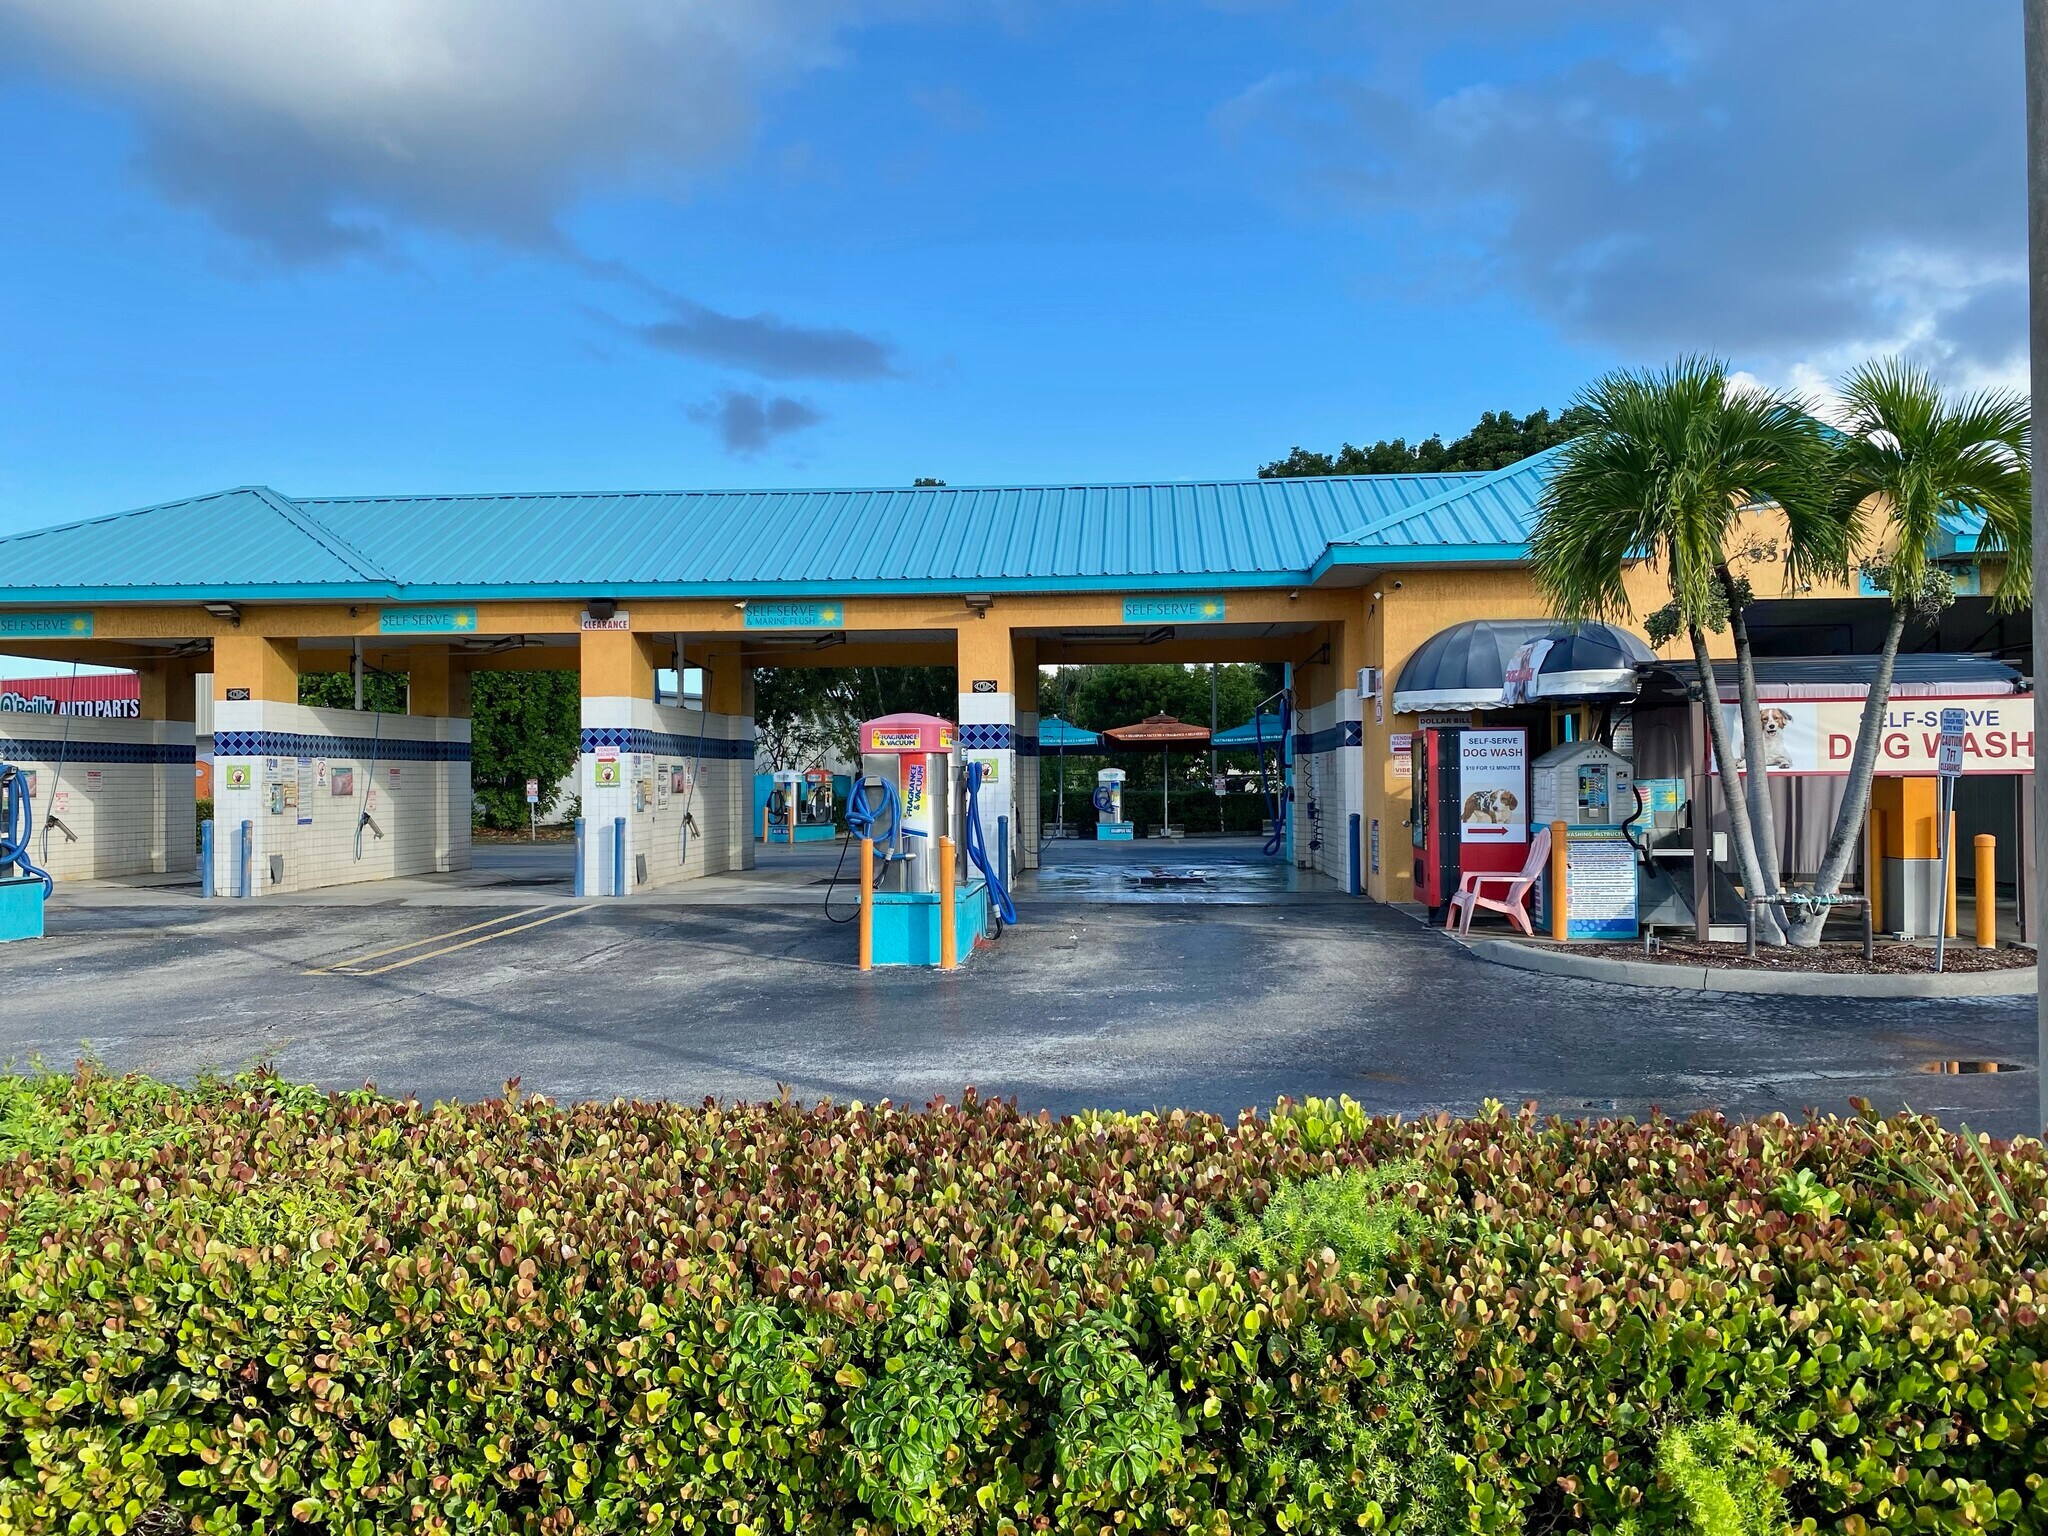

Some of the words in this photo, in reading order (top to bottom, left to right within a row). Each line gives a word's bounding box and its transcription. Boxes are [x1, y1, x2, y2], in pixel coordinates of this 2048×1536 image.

[746, 605, 774, 617] SELF
[776, 605, 815, 616] SERVE
[1125, 604, 1153, 616] SELF
[1156, 603, 1197, 615] SERVE
[1, 620, 27, 632] SELF
[30, 619, 67, 631] SERVE
[382, 614, 409, 626] SELF
[412, 614, 449, 625] SERVE
[583, 620, 628, 630] CLEARANCE
[755, 617, 788, 626] MARINE
[789, 617, 815, 625] FLUSH
[0, 692, 56, 714] O'Reilly
[59, 700, 94, 717] AUTO
[95, 699, 140, 718] PARTS
[1860, 711, 2000, 728] LF-SVE
[1468, 737, 1520, 745] SELF-SERVE
[1829, 733, 1910, 759] DG
[1941, 735, 1963, 747] CAUTION
[1463, 748, 1488, 757] DOG
[1490, 748, 1523, 757] WASH
[1940, 763, 1962, 772] CLEARANCE
[913, 765, 924, 802] VACUUM
[906, 765, 918, 817] FRAGRANCE
